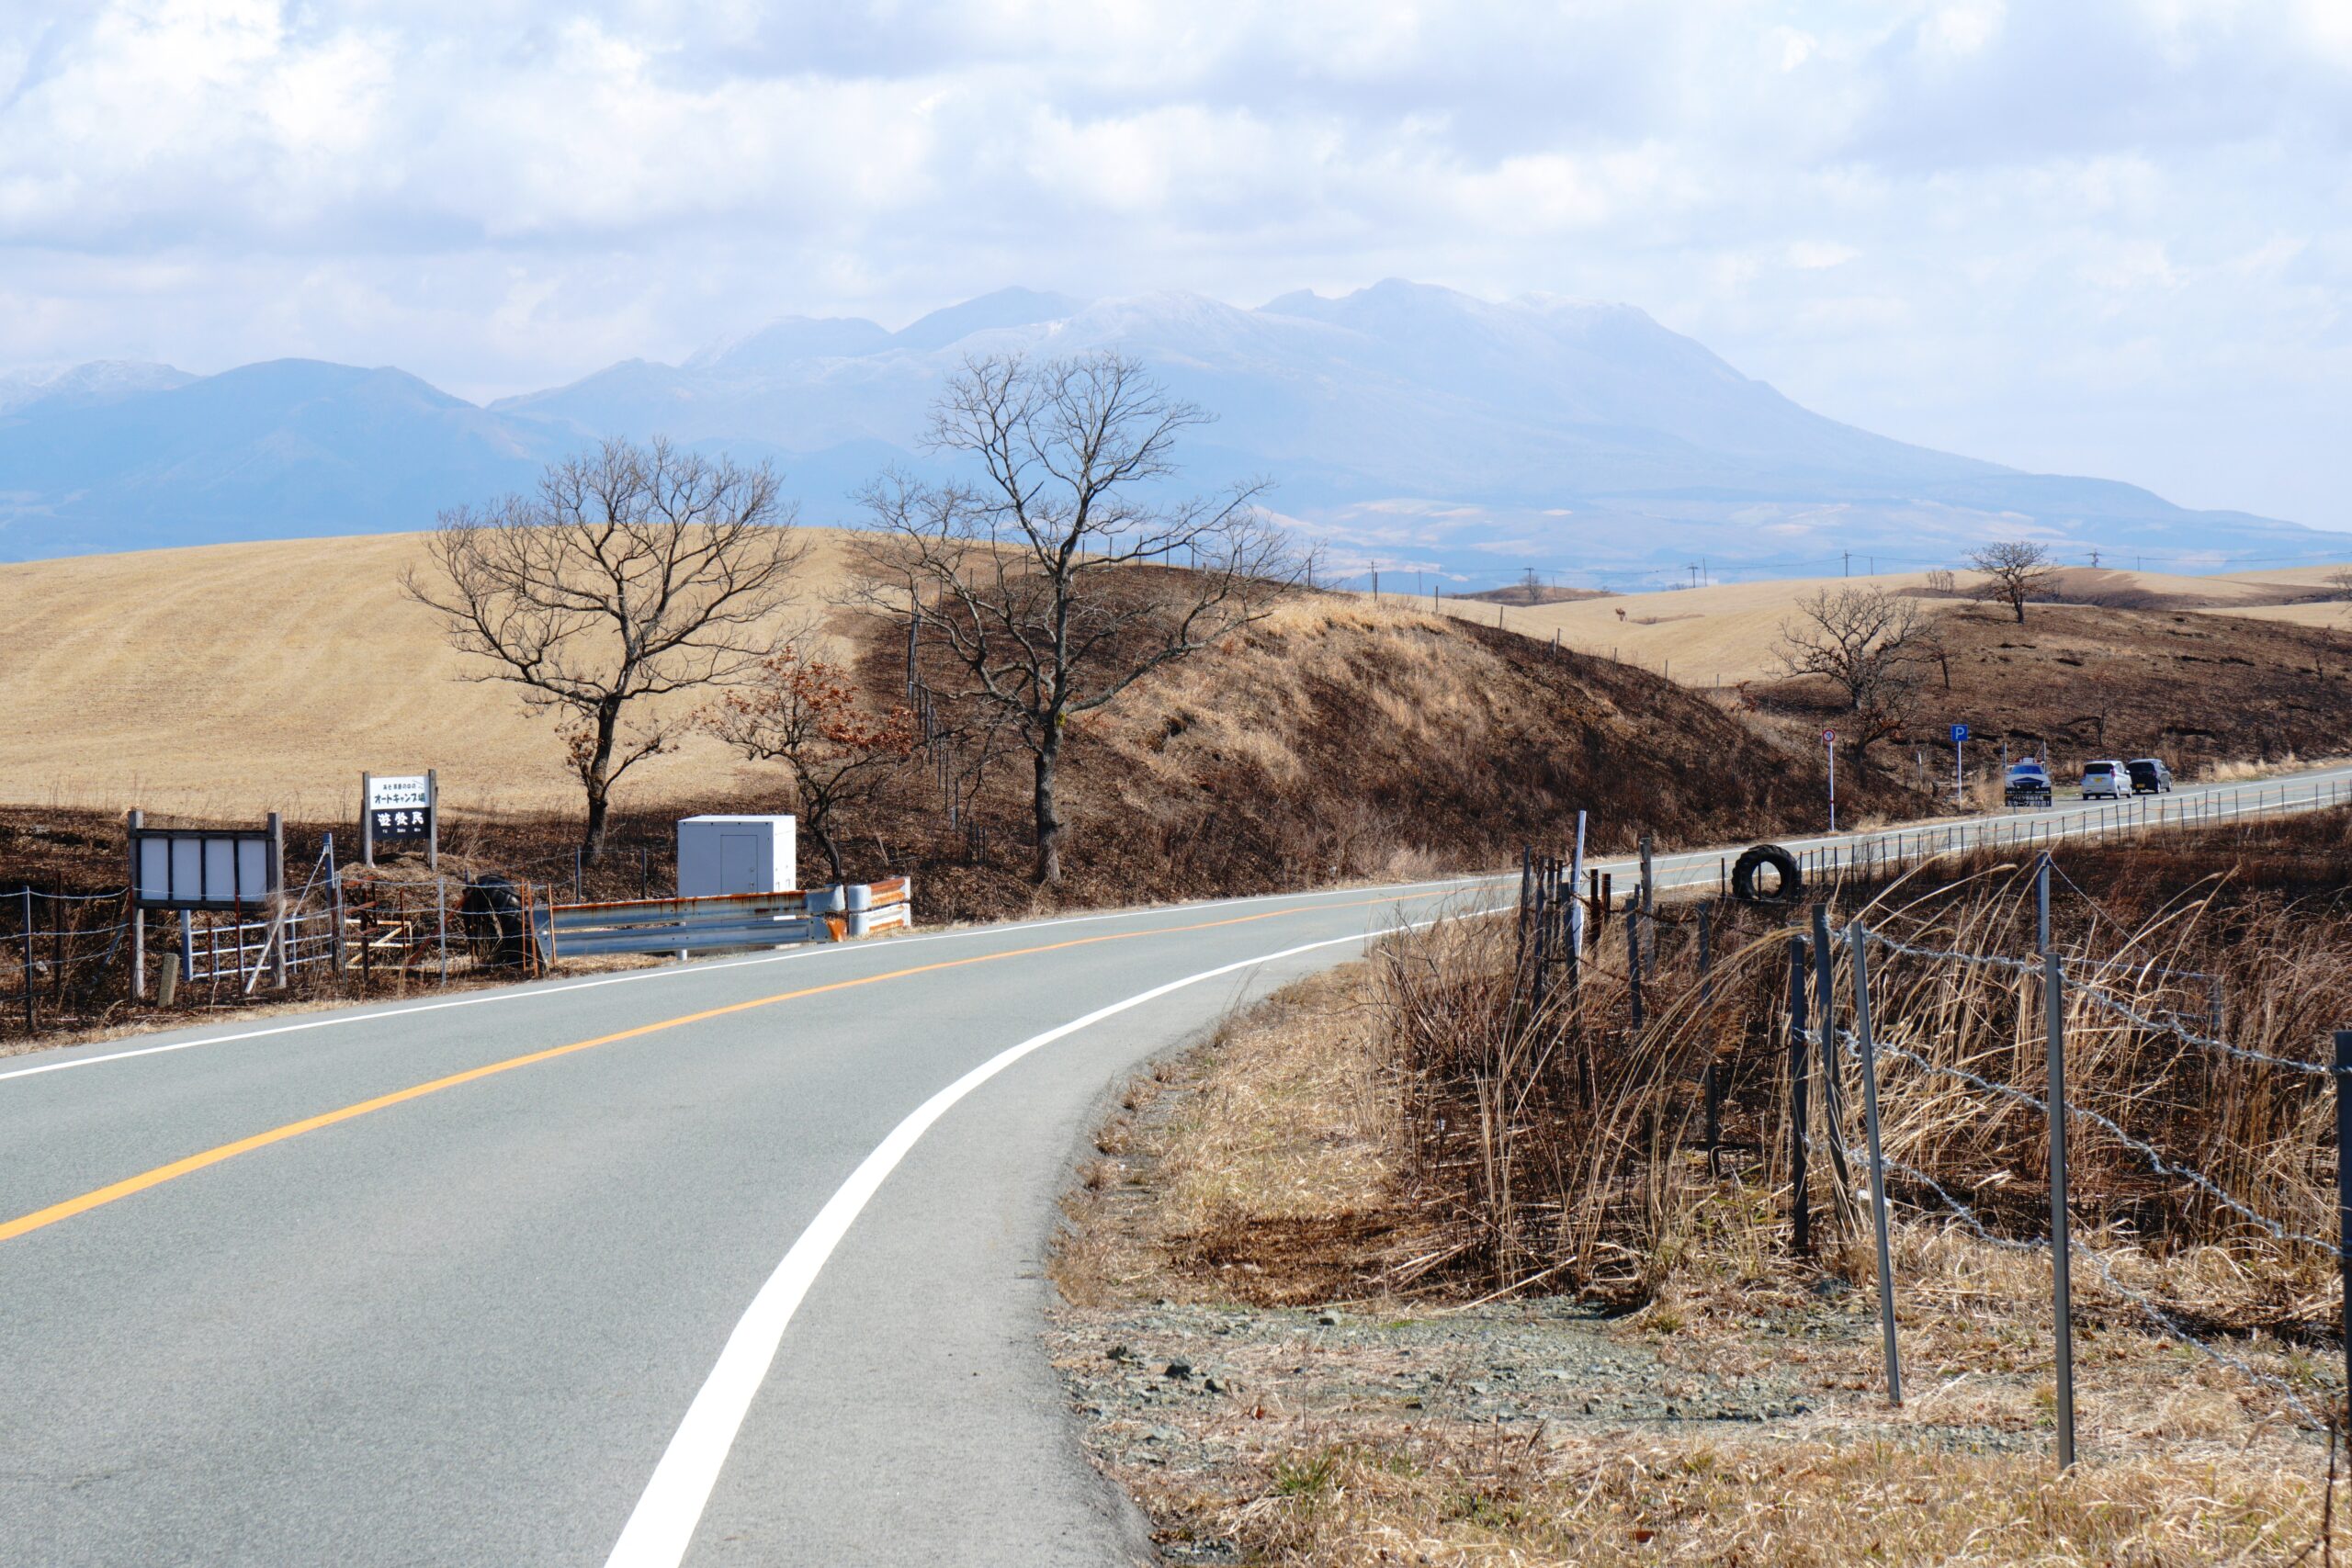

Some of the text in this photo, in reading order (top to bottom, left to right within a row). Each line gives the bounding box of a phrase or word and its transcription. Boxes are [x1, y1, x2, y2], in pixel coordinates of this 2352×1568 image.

[1955, 728, 1965, 739] P
[377, 811, 424, 827] 遊牧民
